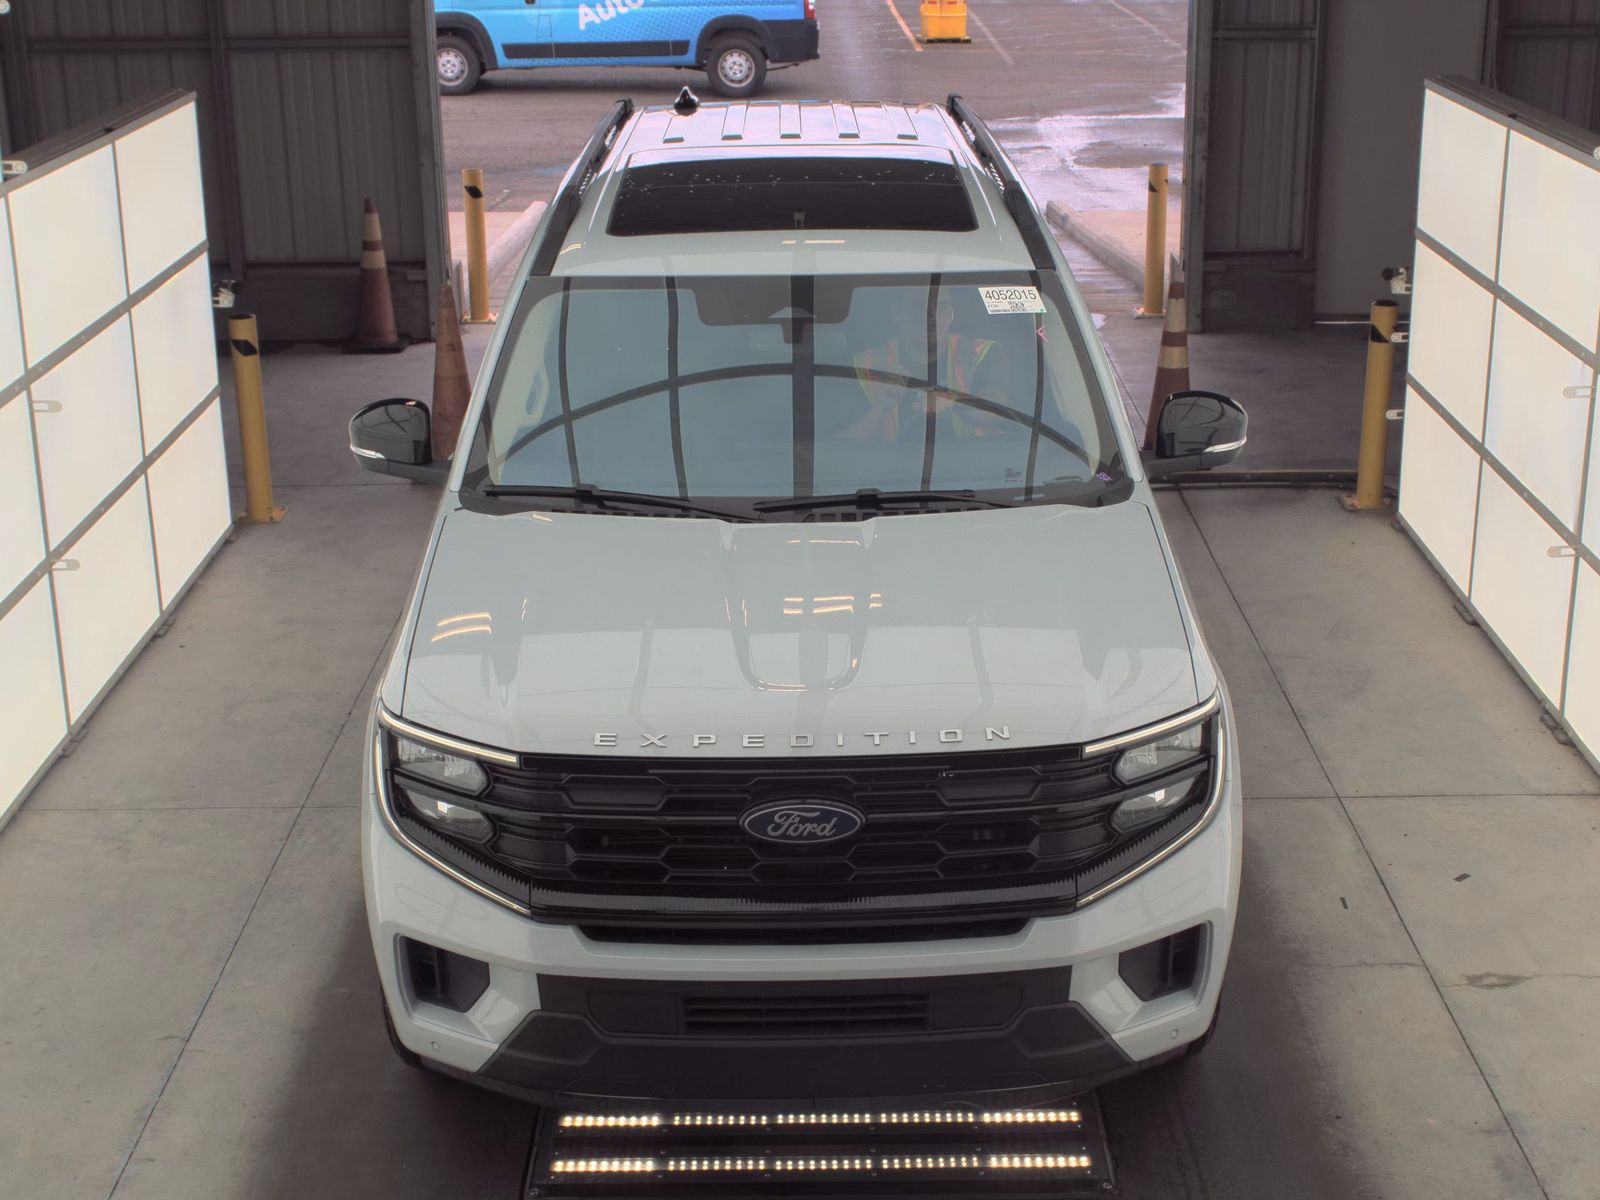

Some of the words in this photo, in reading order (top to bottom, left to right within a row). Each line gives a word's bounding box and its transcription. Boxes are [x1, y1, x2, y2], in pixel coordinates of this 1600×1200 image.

[985, 289, 1037, 301] 4052015
[593, 725, 1010, 748] EXPEDITION
[767, 810, 839, 837] Ford
